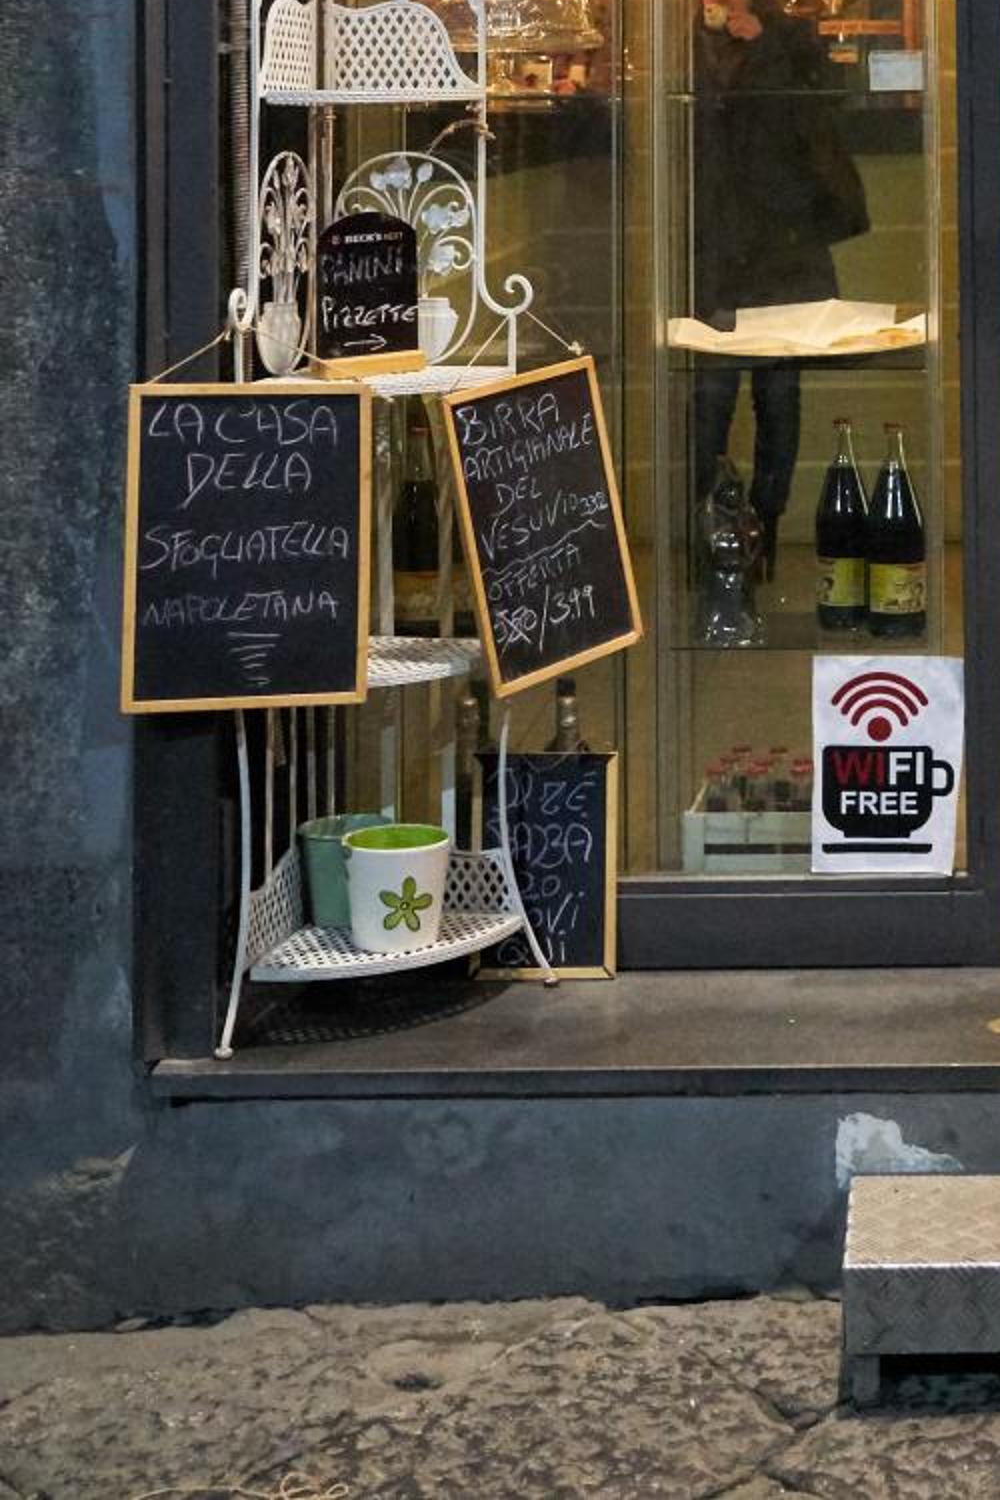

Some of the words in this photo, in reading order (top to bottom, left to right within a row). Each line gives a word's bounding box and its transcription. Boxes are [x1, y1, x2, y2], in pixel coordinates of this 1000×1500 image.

[148, 402, 204, 446] LA
[214, 400, 338, 446] CASA
[177, 450, 313, 510] DELLA
[494, 475, 543, 516] DEL
[830, 751, 925, 788] WIFI
[840, 790, 919, 815] FREE
